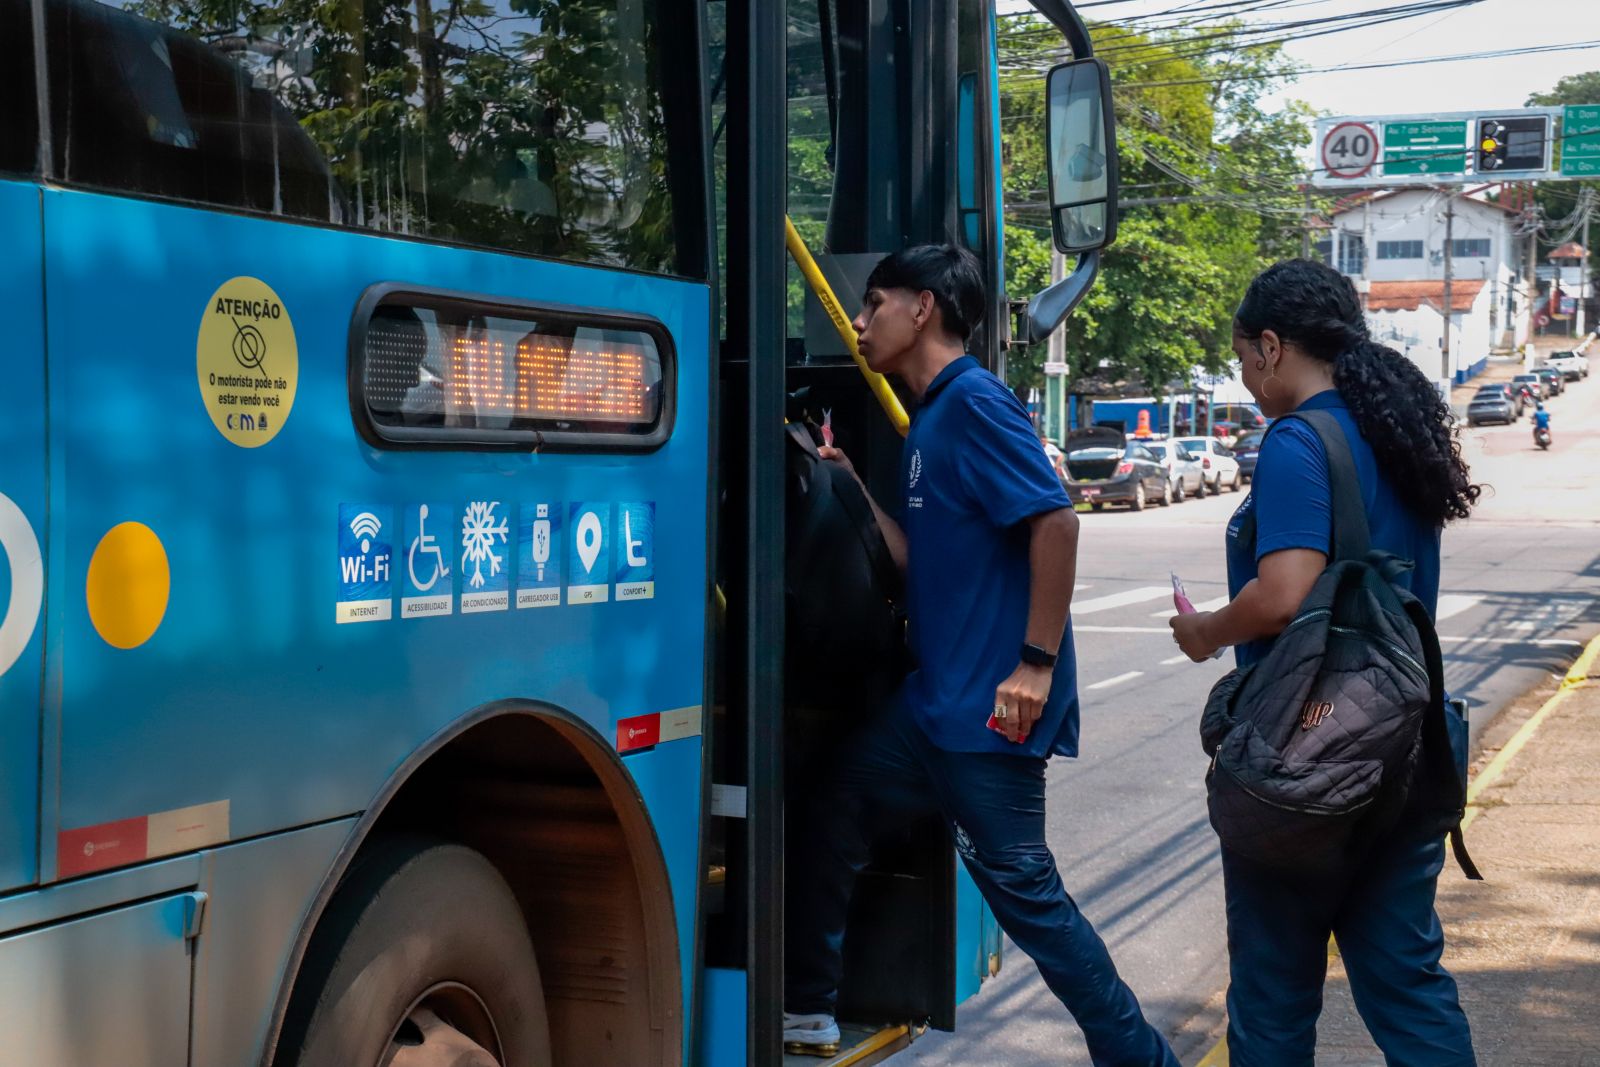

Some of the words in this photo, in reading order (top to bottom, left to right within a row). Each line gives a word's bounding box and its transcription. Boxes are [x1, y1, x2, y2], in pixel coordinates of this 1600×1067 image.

[1579, 110, 1598, 119] Dom
[1329, 134, 1369, 158] 40
[216, 297, 280, 322] ATENÇÃO
[209, 373, 215, 386] O
[217, 375, 253, 388] motorista
[254, 375, 272, 391] pode
[274, 376, 287, 390] não
[218, 394, 238, 405] estar
[240, 394, 261, 406] vendo
[263, 394, 280, 407] você
[341, 554, 389, 584] Wi-Fi
[518, 594, 549, 604] CARREGADOR
[550, 593, 559, 602] USB
[583, 591, 593, 599] GPS
[407, 601, 448, 613] ACESSIBILIDADE
[463, 599, 470, 608] AR
[470, 596, 508, 607] CONDICIONADO
[350, 606, 378, 617] INTERNET
